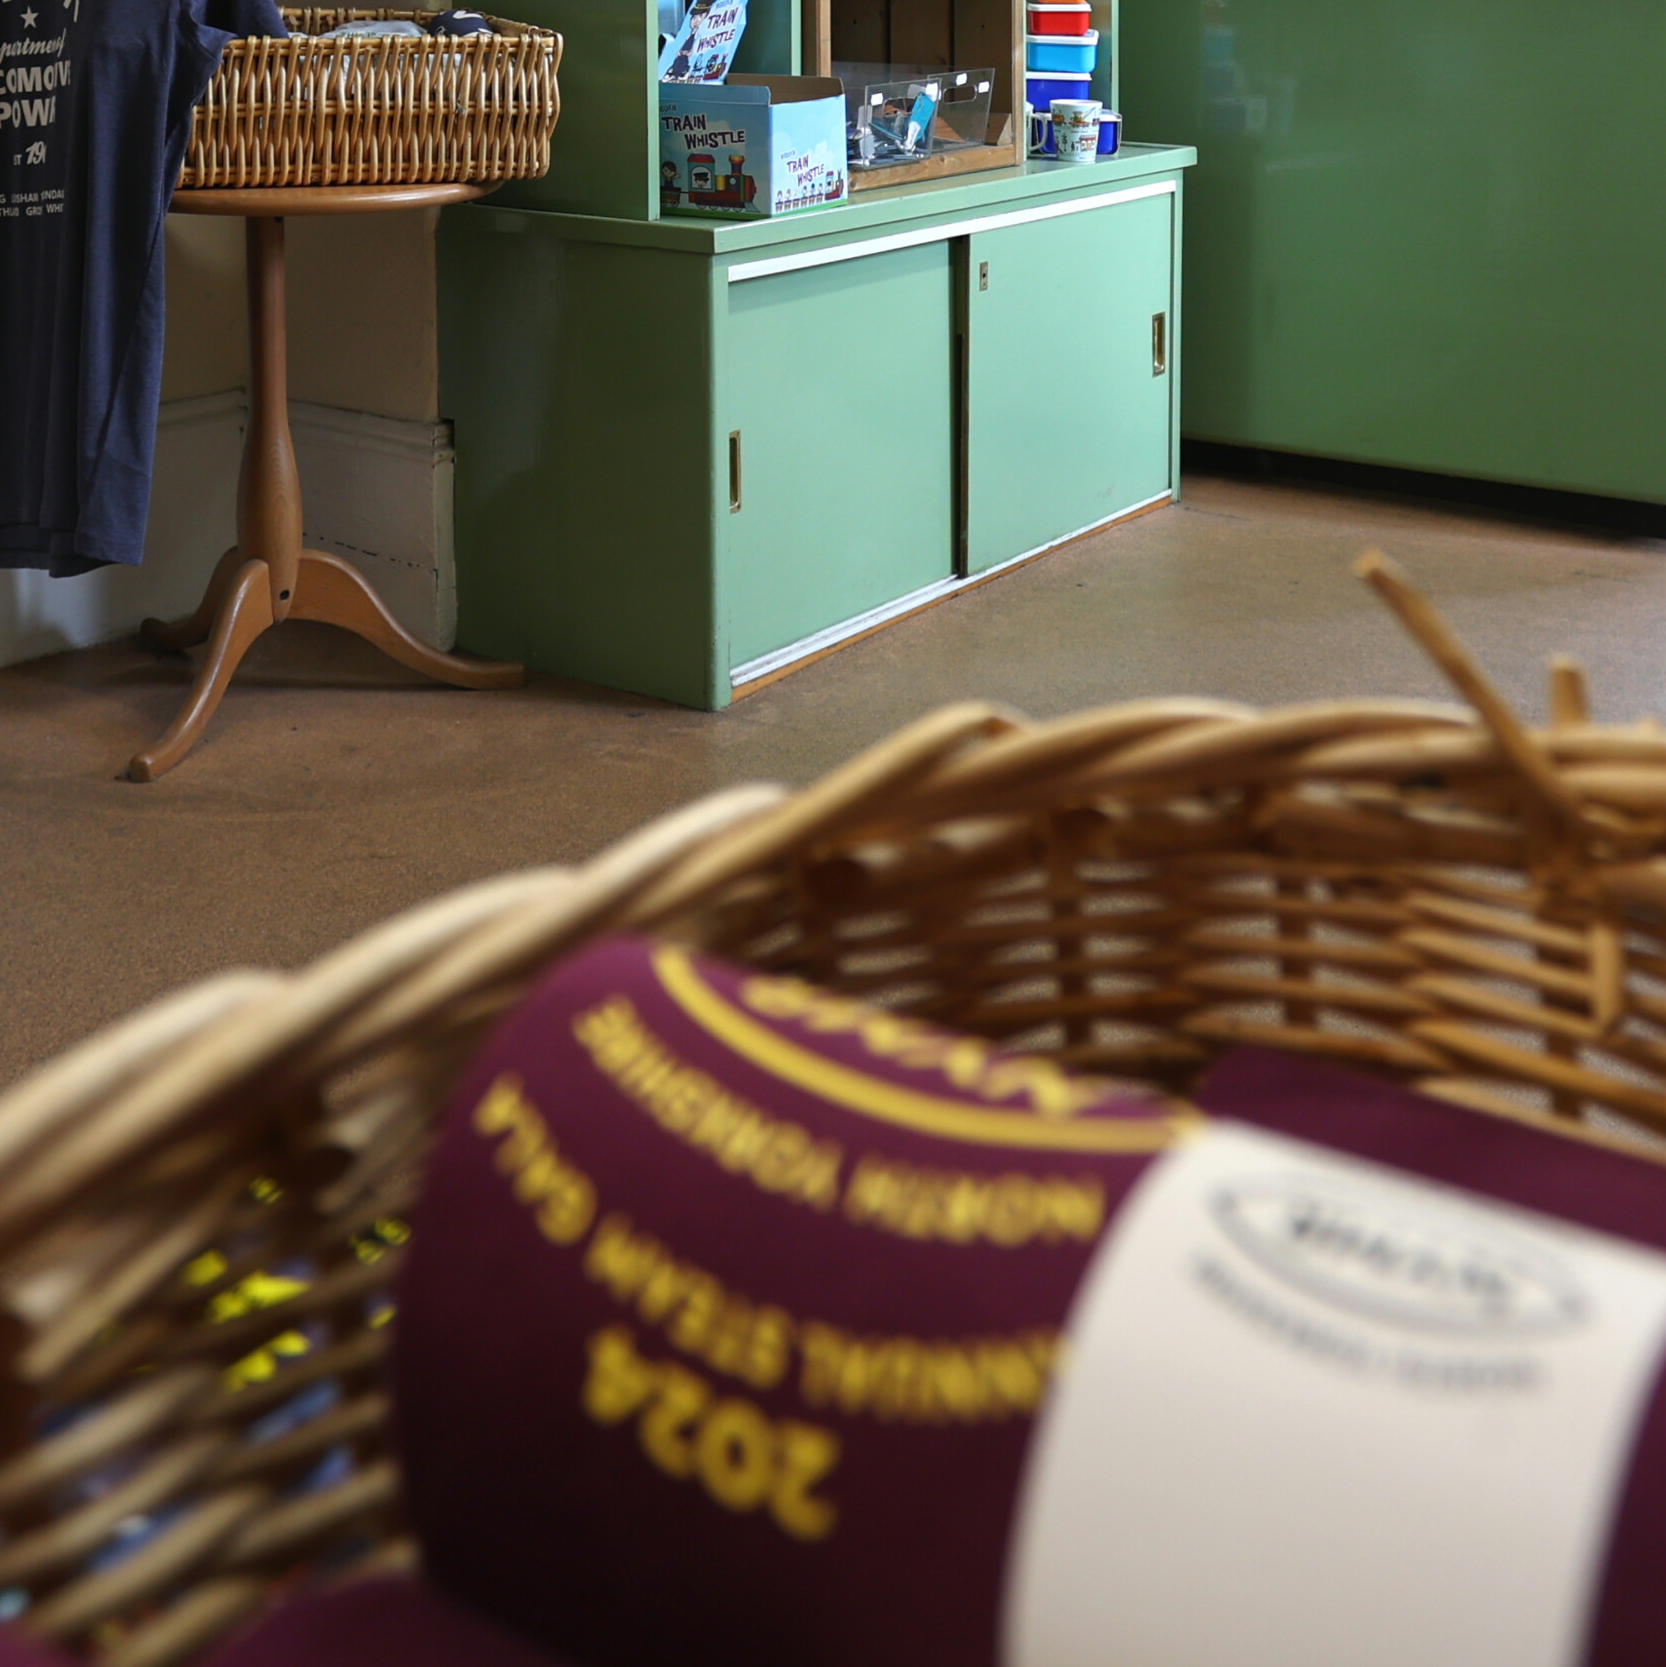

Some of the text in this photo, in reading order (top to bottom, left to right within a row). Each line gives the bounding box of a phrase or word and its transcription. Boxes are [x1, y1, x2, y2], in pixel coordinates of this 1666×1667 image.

[707, 7, 738, 30] TRAIN
[696, 28, 735, 53] WHISTLE
[662, 113, 706, 132] TRAIN
[685, 131, 745, 150] WHISTLE
[787, 154, 809, 174] TRAIN
[797, 163, 825, 187] WHISTLE
[573, 994, 1105, 1246] NORTH YORKSHIRE
[473, 1071, 596, 1246] GALA
[583, 1212, 793, 1388] STEAM
[583, 1324, 837, 1542] 2024
